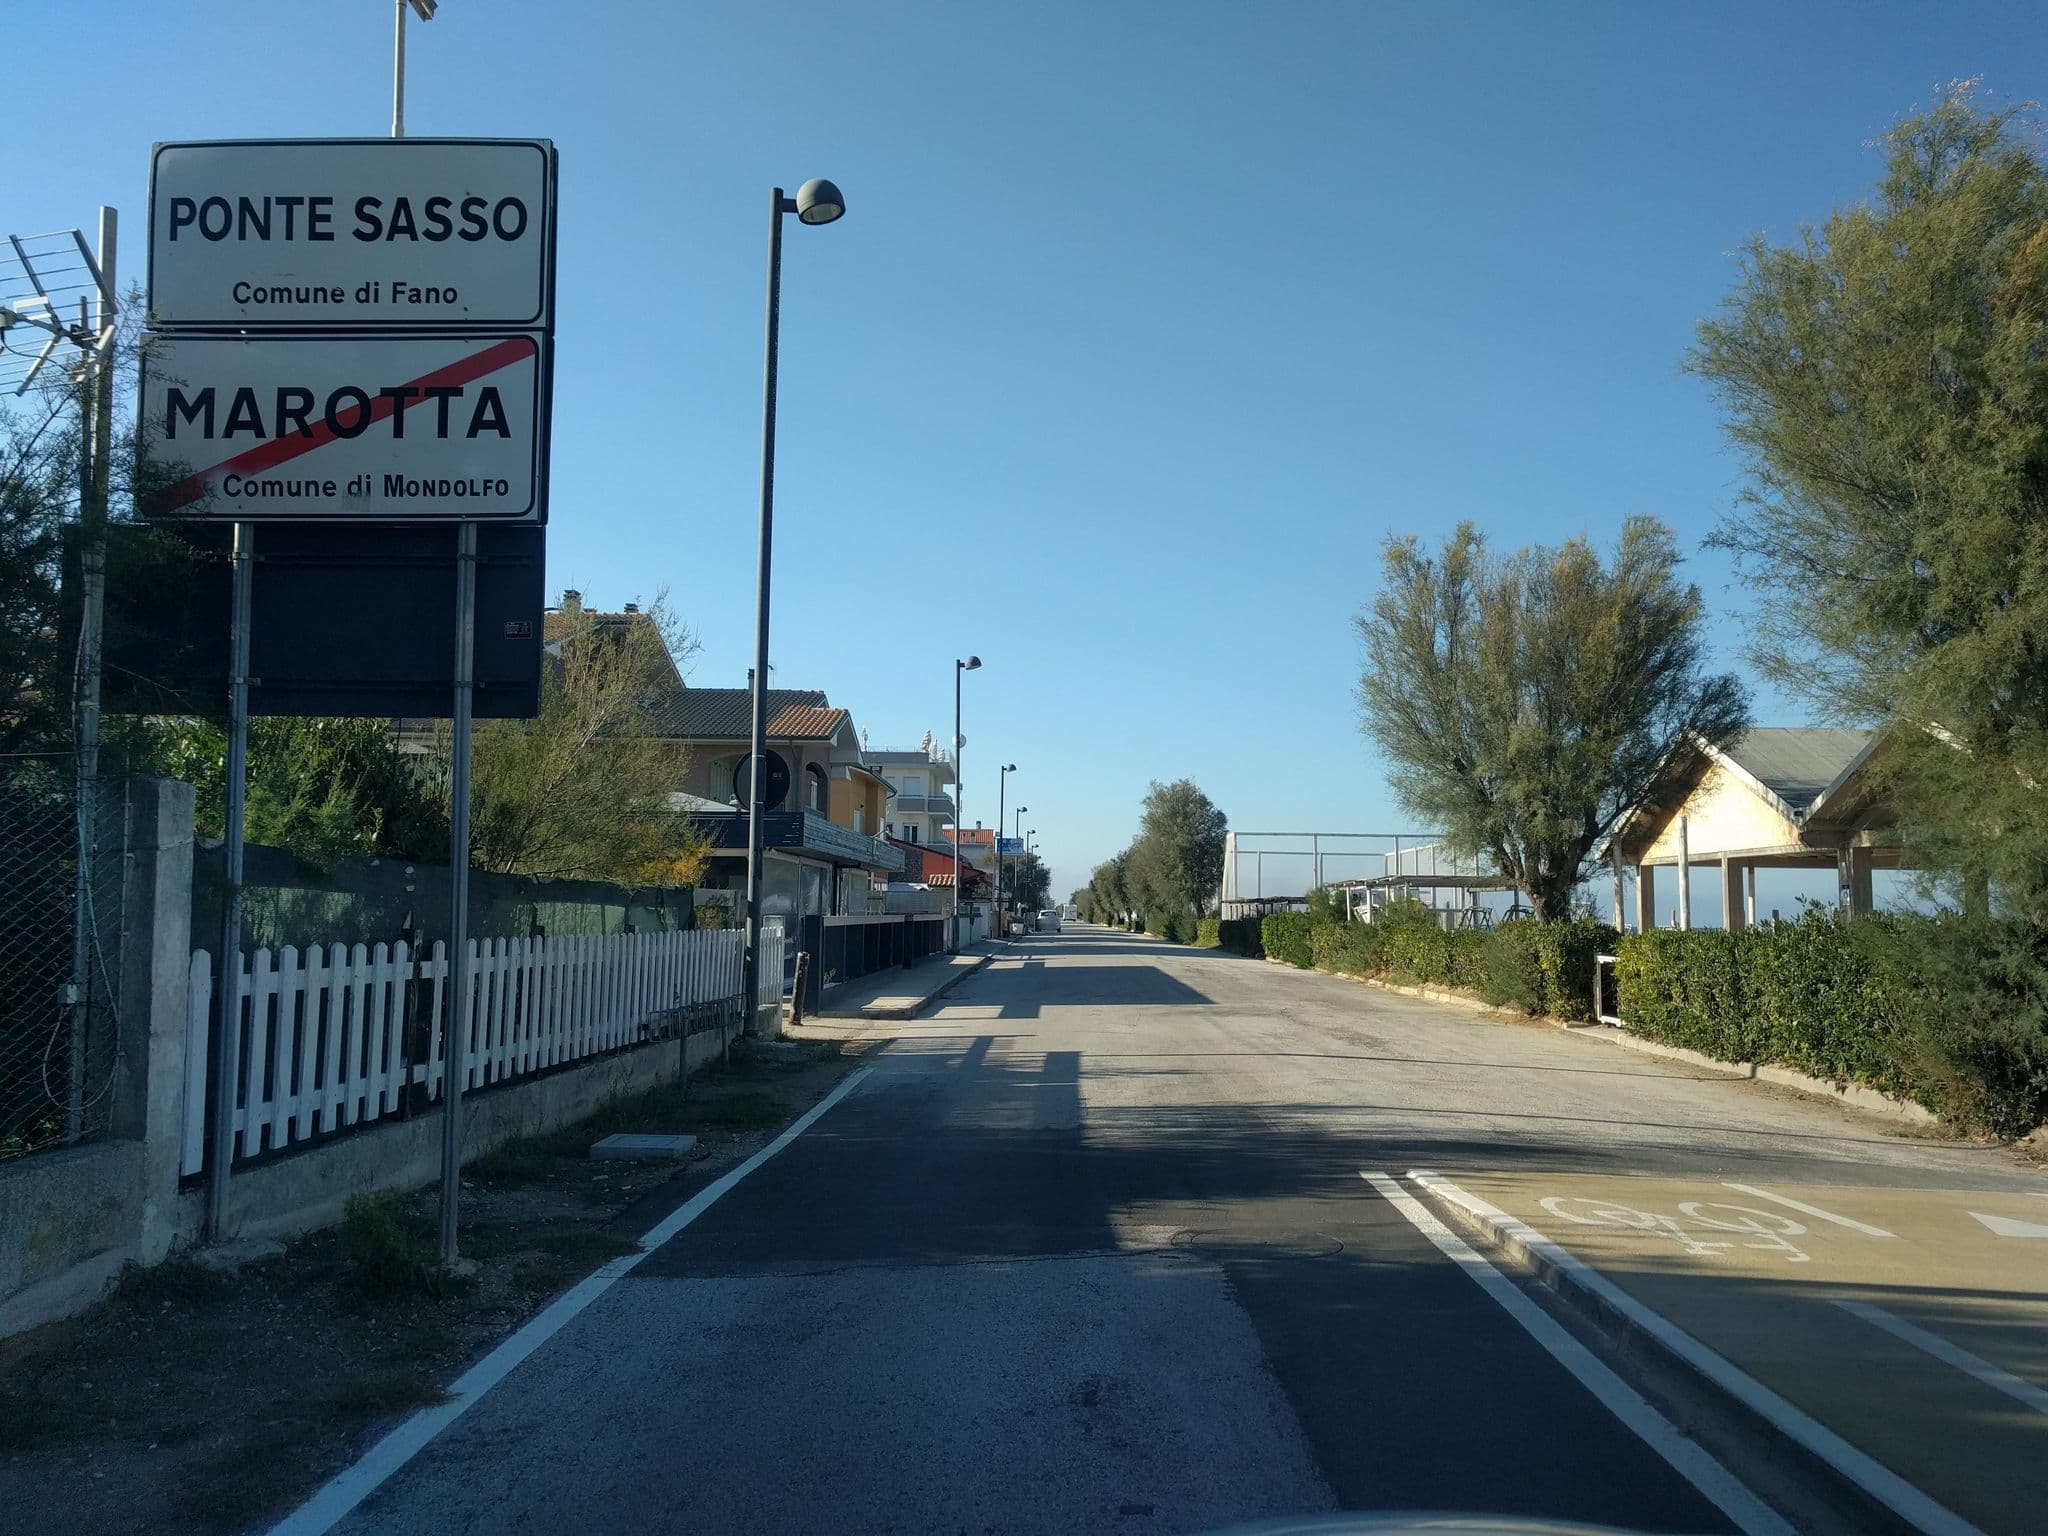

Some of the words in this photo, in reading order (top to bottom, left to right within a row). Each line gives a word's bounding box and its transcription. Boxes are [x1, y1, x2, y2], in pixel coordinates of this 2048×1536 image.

[169, 196, 335, 242] PONTE
[352, 196, 528, 243] SASSO
[232, 281, 345, 304] Comune
[354, 281, 380, 304] di
[392, 282, 458, 304] Fano
[165, 386, 511, 440] MAROTTA
[223, 474, 337, 498] Comune
[347, 474, 372, 497] di
[383, 474, 510, 497] MONDOLFO
